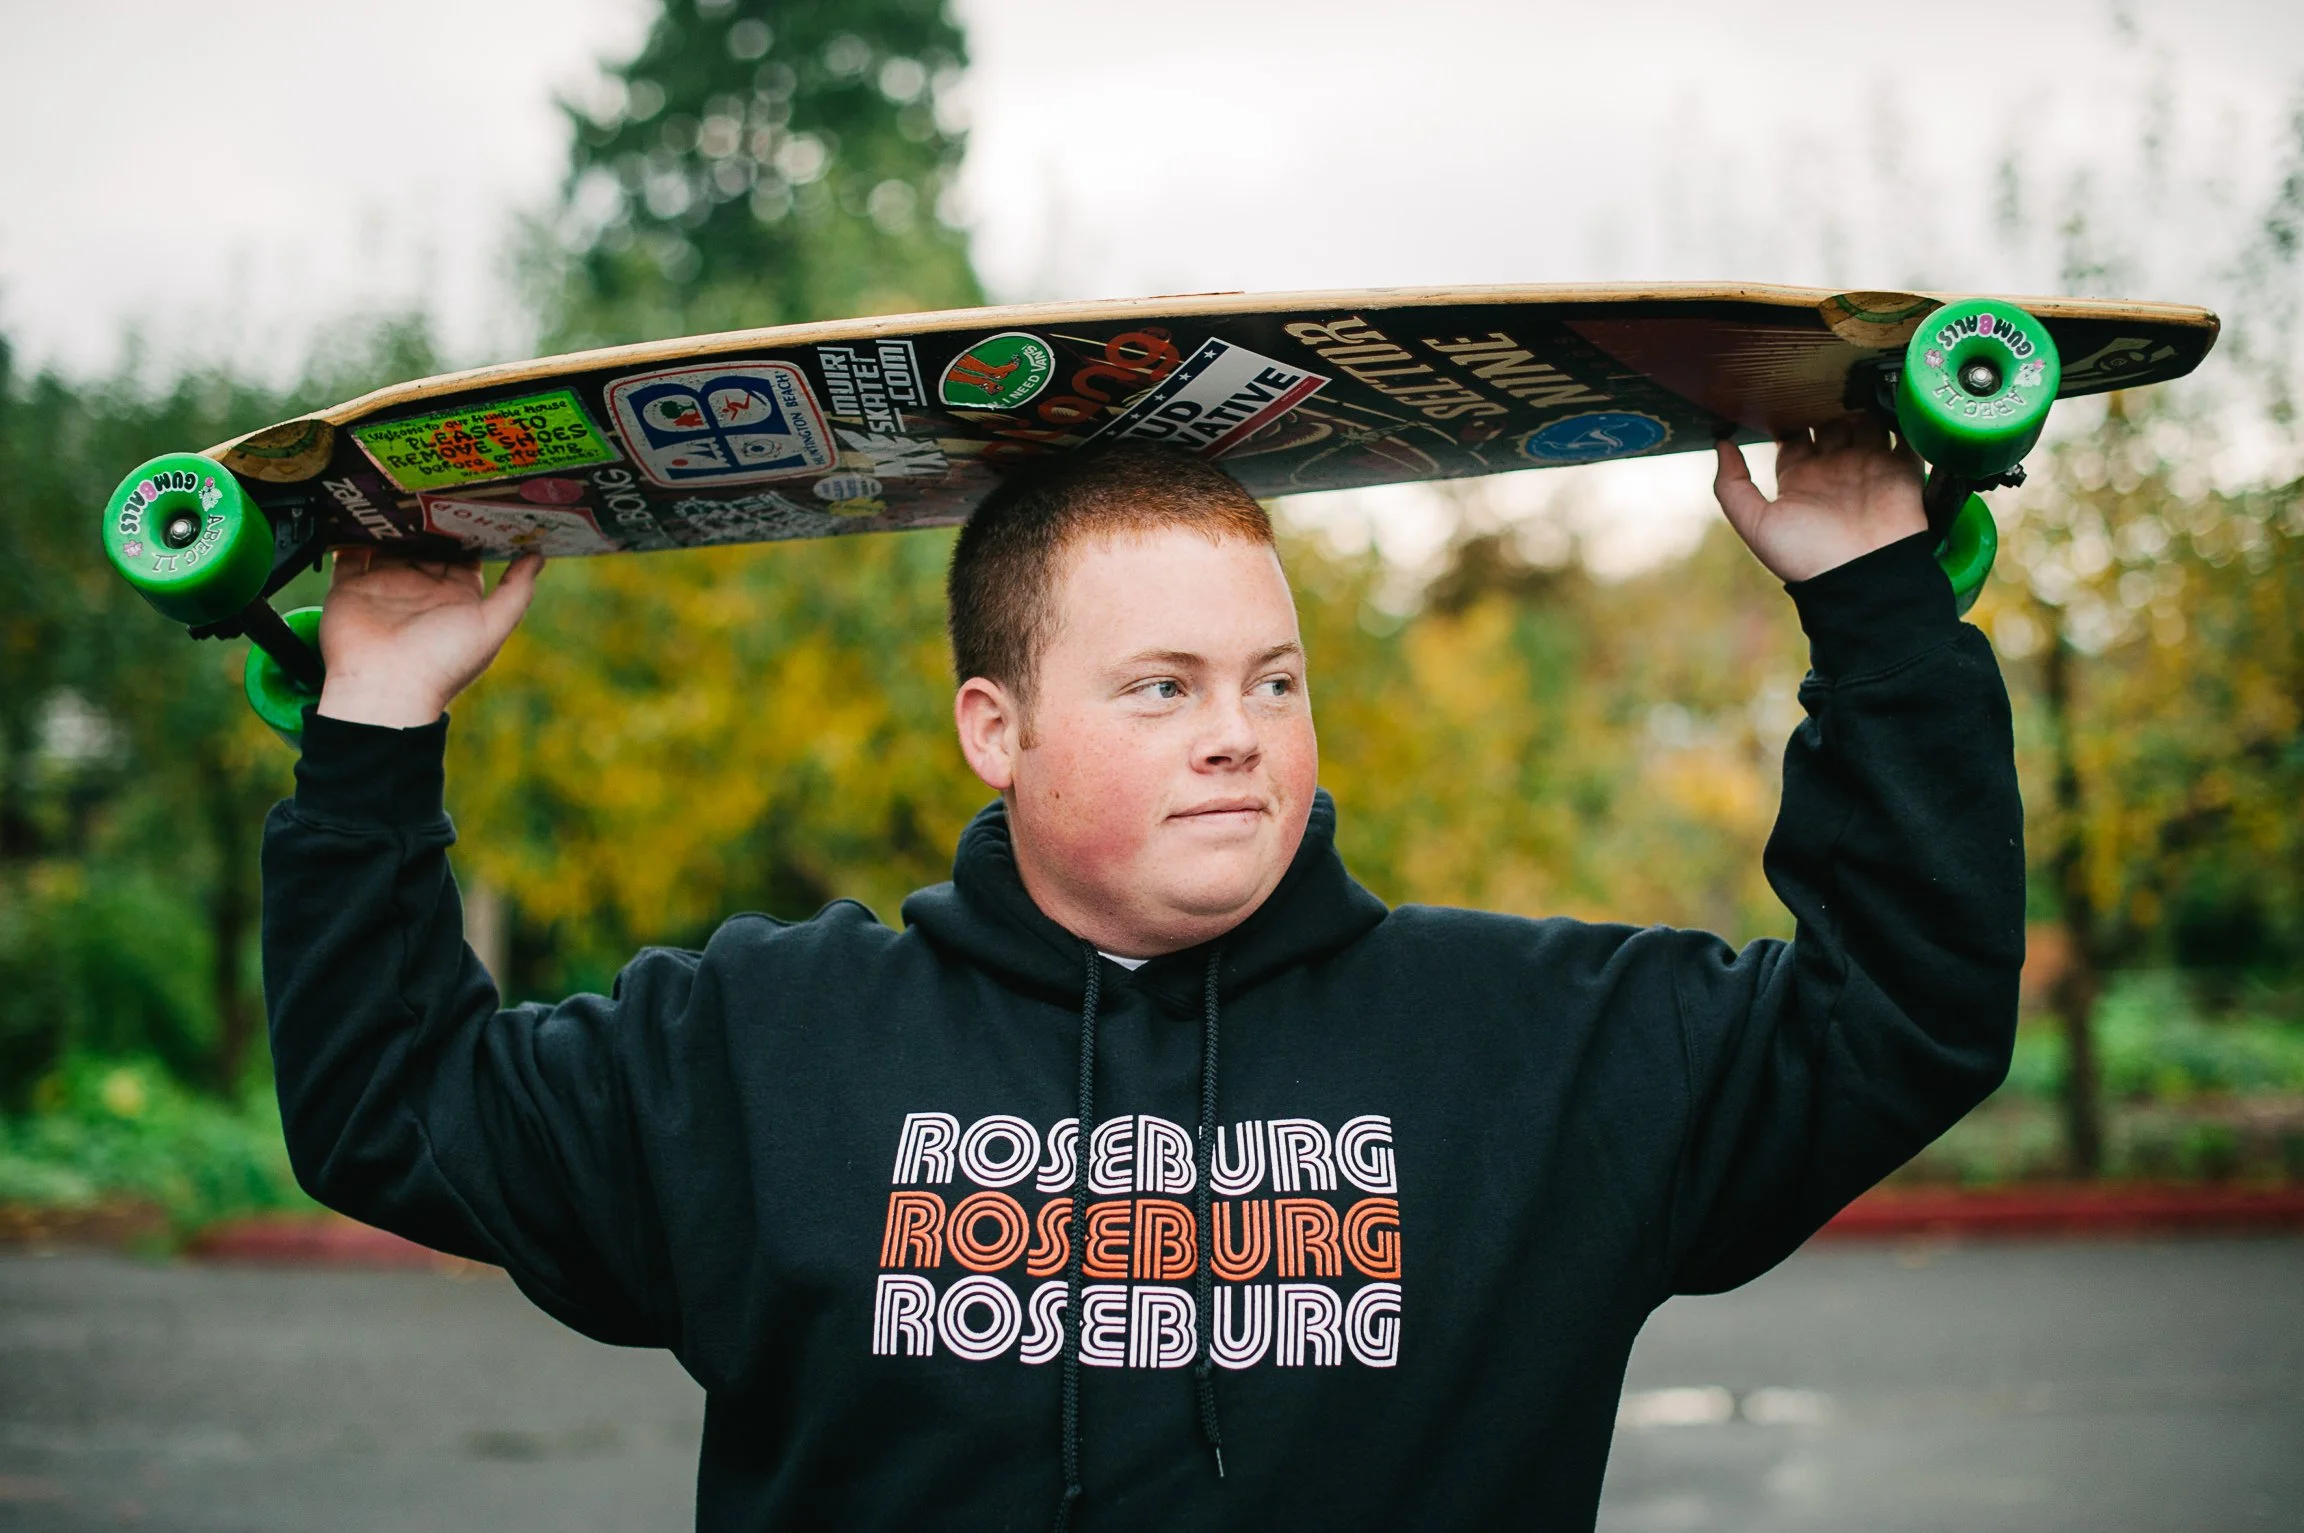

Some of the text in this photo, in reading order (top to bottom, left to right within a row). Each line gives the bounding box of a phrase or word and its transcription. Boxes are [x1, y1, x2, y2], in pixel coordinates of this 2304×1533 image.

[1021, 344, 1047, 372] VANS
[1936, 313, 2035, 359] GUMBALLS
[820, 354, 861, 415] MUIR
[1009, 375, 1040, 399] NEED
[1283, 316, 1508, 420] SECTOR
[1422, 333, 1611, 408] NINE
[776, 373, 826, 465] HUNTINGTON BEACH
[1963, 386, 2027, 419] ABEC
[387, 441, 492, 470] REMOVE
[501, 423, 589, 450] SHOES
[405, 415, 547, 450] PLEASE TO
[418, 457, 486, 475] before
[119, 470, 198, 534] GUMBALLS
[184, 514, 225, 567] ABEC
[892, 1112, 1398, 1194] ROSEBURG
[880, 1190, 1401, 1281] ROSEBURG
[872, 1274, 1401, 1370] ROSEBURG
